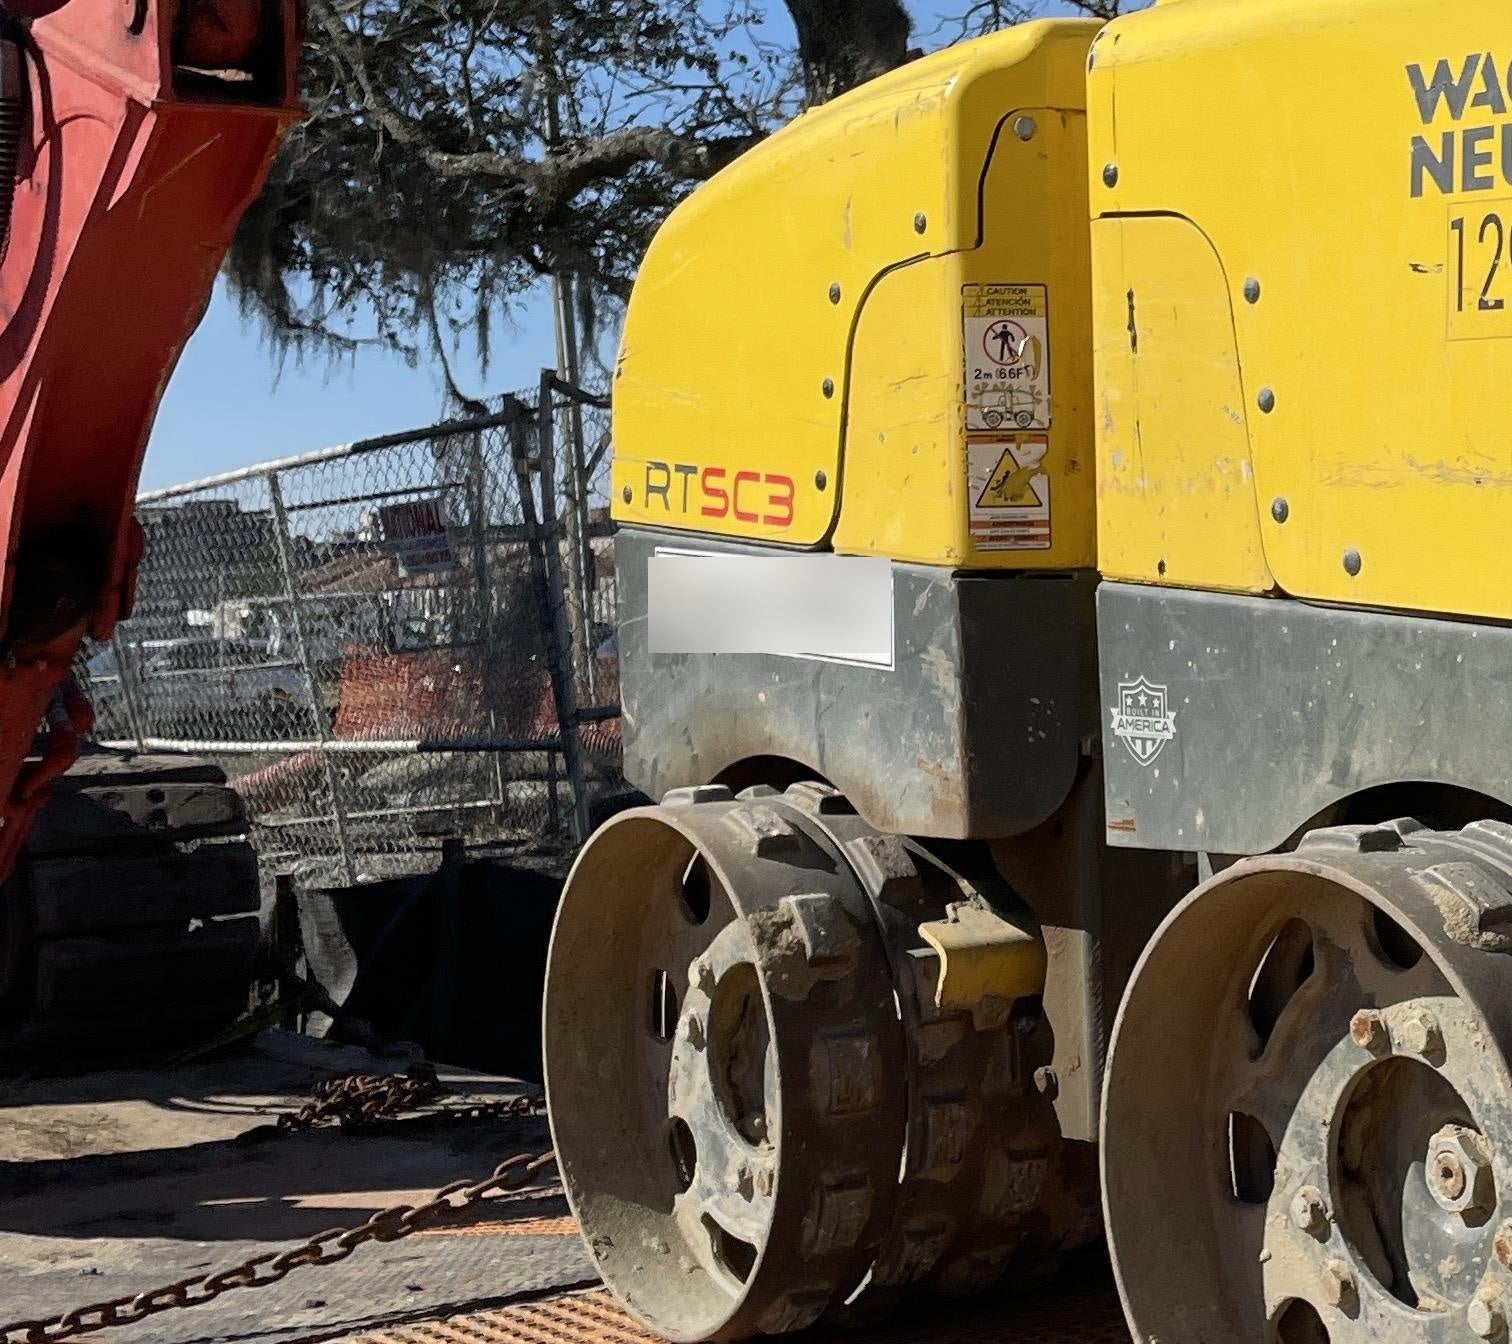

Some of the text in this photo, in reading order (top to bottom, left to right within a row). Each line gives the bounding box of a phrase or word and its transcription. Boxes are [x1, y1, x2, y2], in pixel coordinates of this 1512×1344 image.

[985, 297, 1031, 306] ATENCIÓN
[985, 308, 1037, 316] ATTENTION
[644, 460, 796, 527] RTSC3
[1126, 707, 1160, 717] BUILT IN
[1116, 718, 1171, 733] AMERICA
